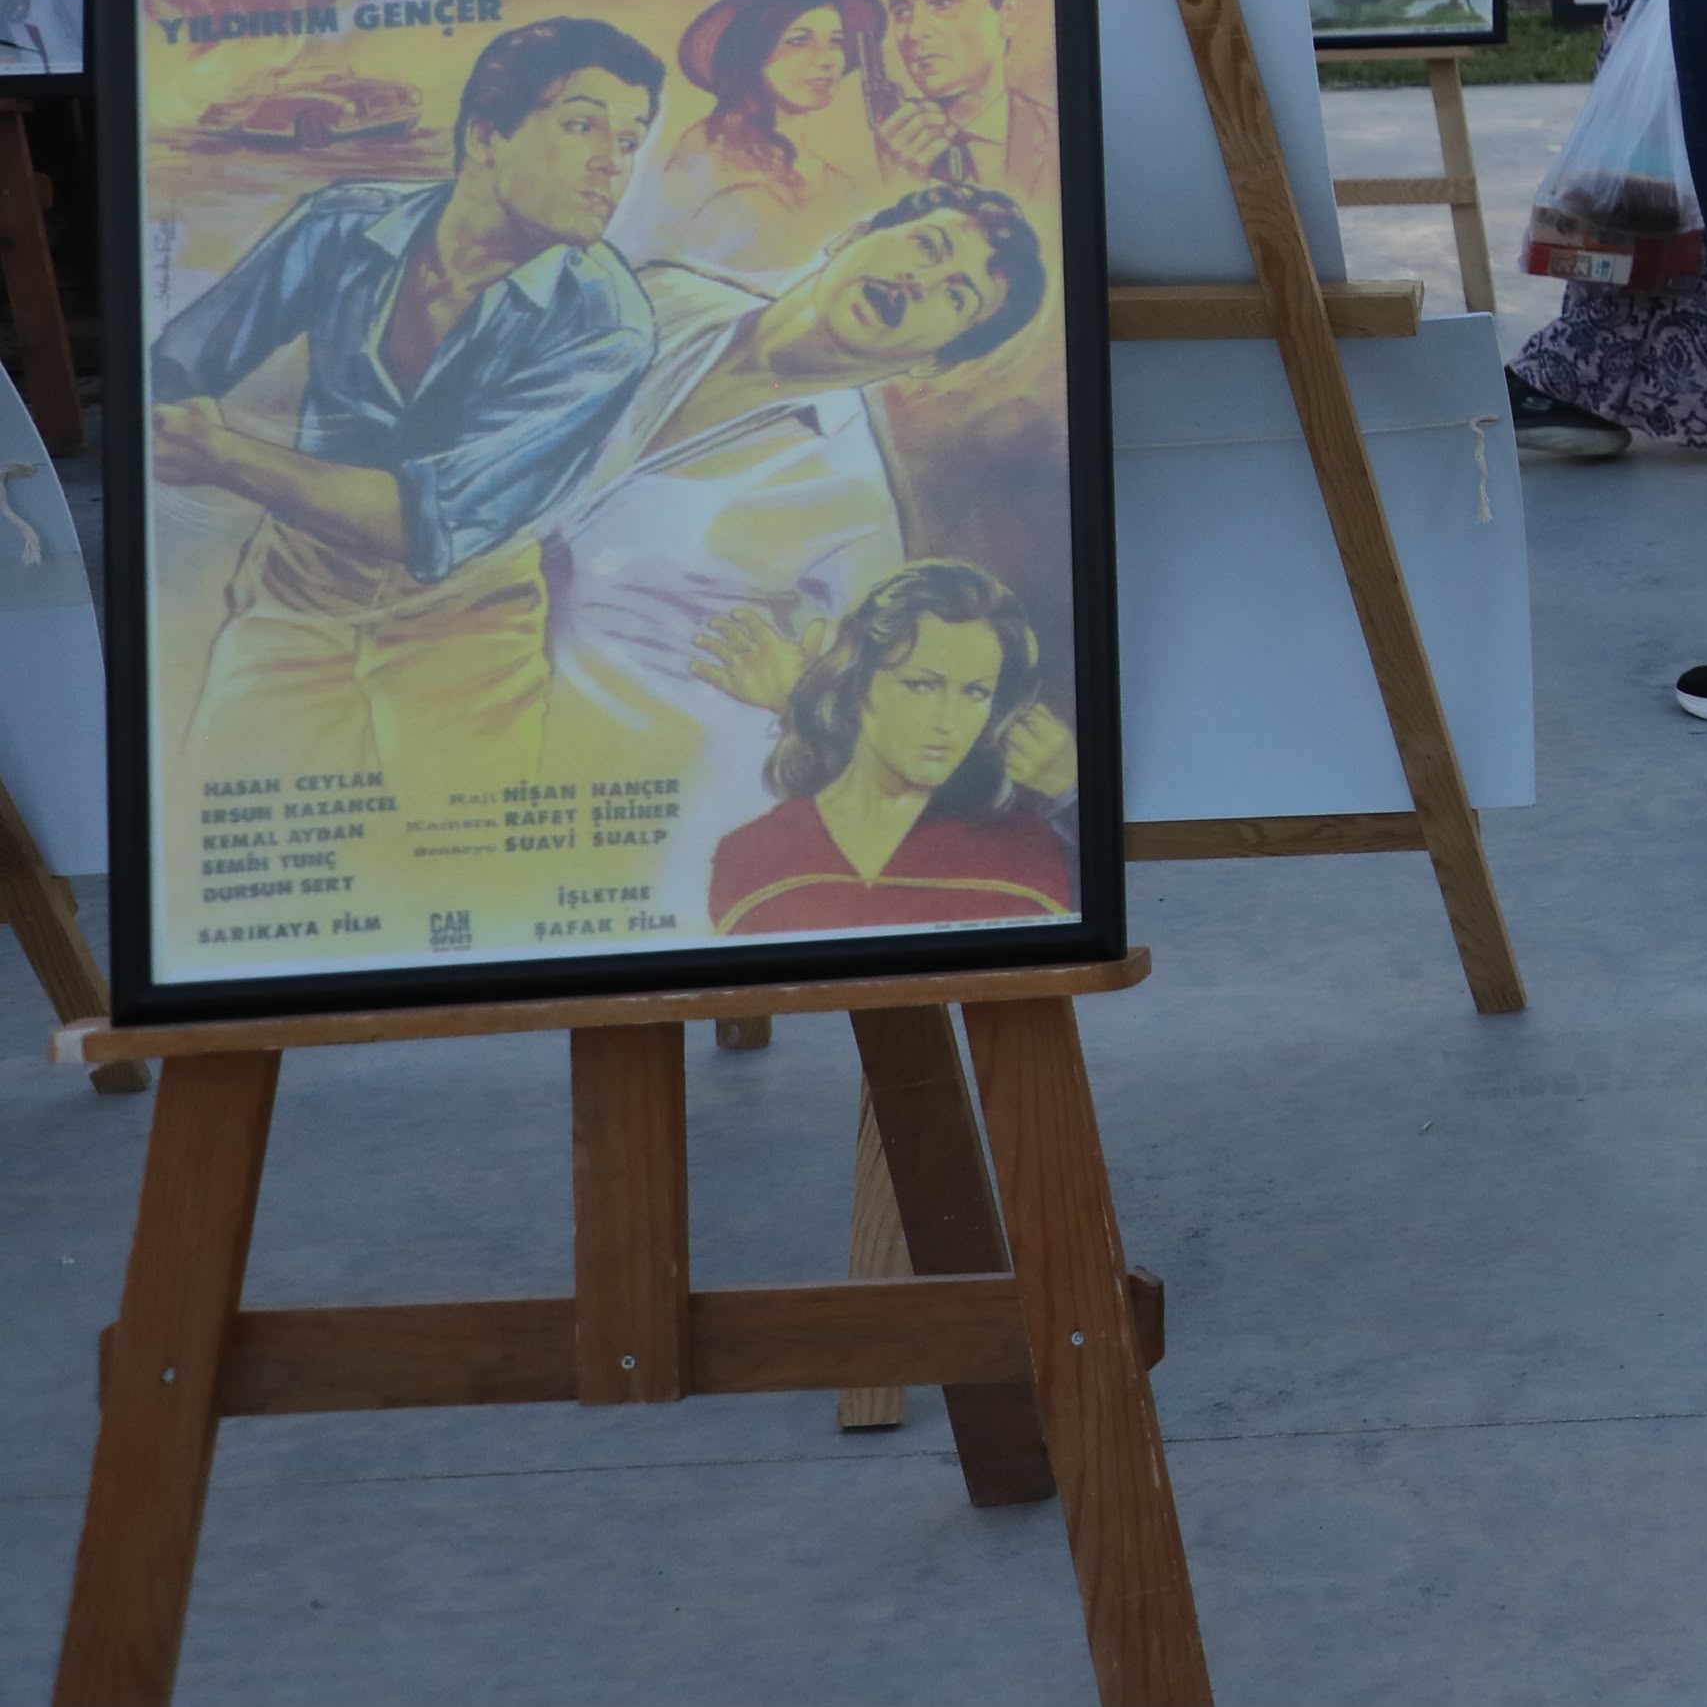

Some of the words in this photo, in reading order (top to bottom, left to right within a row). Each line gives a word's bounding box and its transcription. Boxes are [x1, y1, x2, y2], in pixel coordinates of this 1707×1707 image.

[203, 777, 281, 798] HASAN
[295, 770, 384, 792] CEYLAN
[503, 779, 577, 809] NİŞAN
[592, 778, 680, 801] HANÇER
[504, 807, 578, 829] RAFET
[203, 831, 279, 851] KEMAL
[505, 828, 577, 854] SUAVİ
[592, 828, 669, 848] SUALP
[203, 879, 293, 903] DURSUN
[301, 875, 355, 894] SERT
[558, 884, 652, 910] İŞLETME
[198, 920, 320, 945] SARIKAYA
[332, 910, 382, 934] FİLM
[429, 909, 471, 935] CAN
[534, 917, 614, 942] ŞAFAK
[628, 910, 678, 932] FİLM
